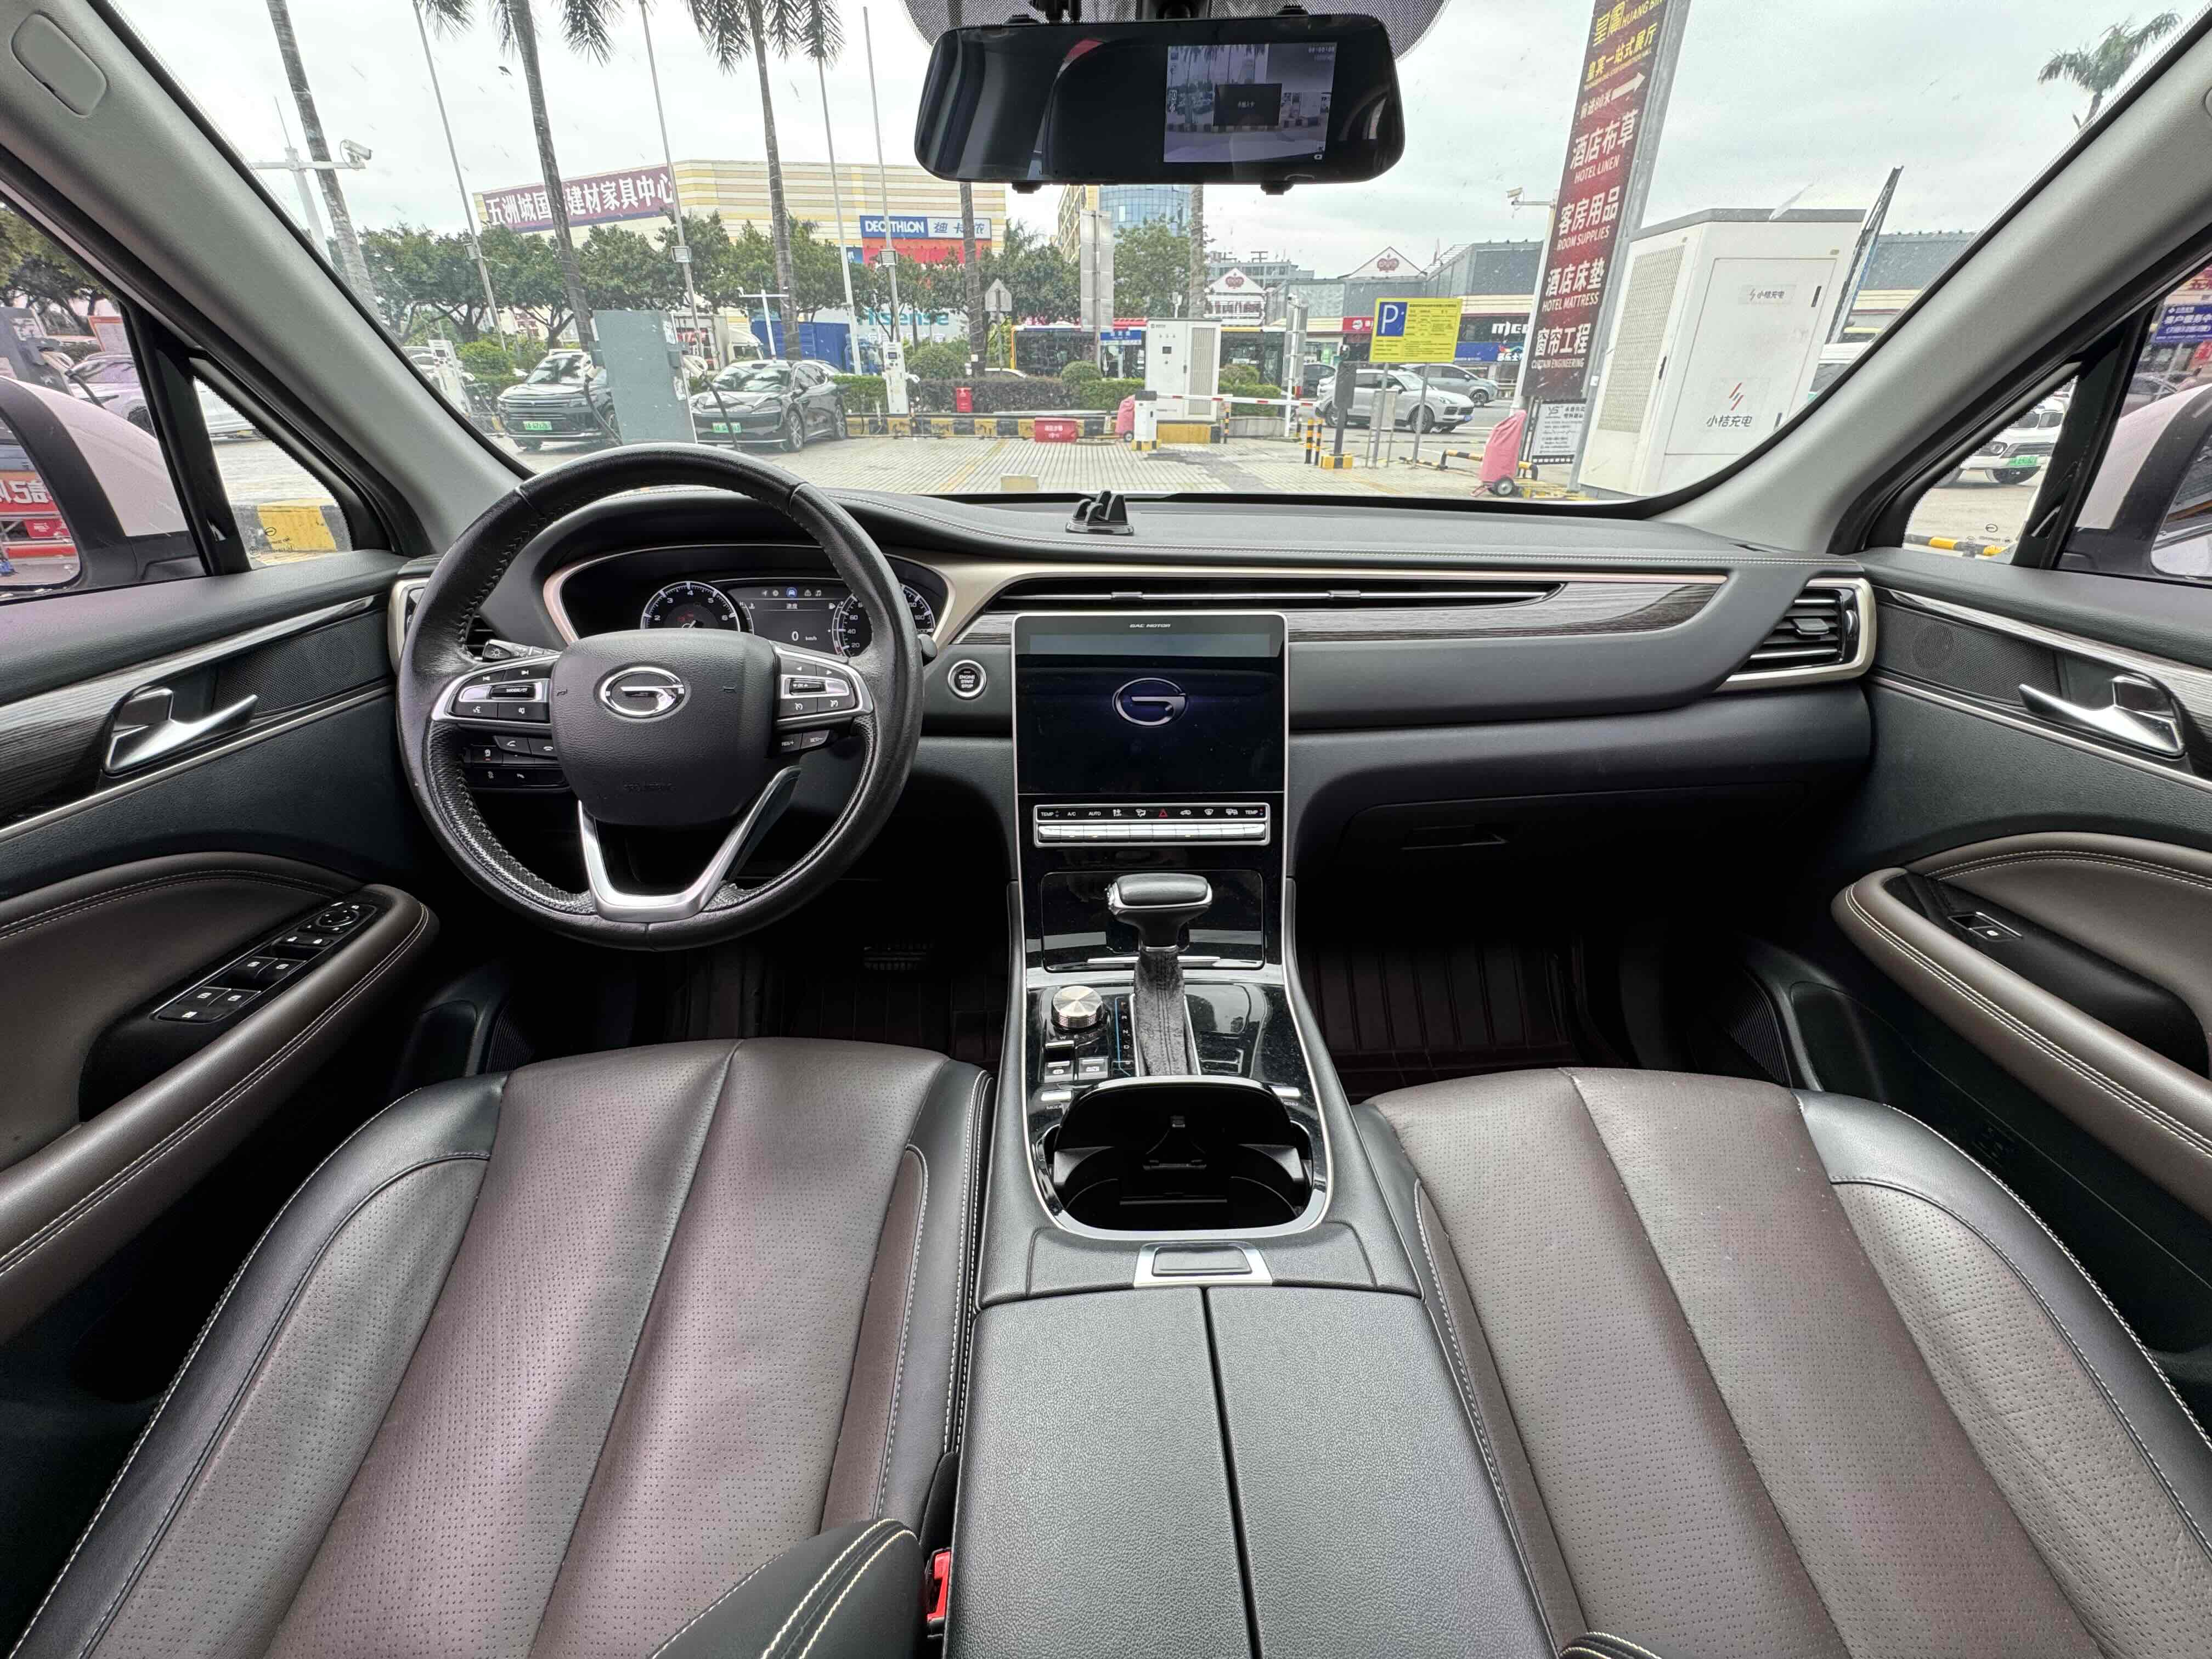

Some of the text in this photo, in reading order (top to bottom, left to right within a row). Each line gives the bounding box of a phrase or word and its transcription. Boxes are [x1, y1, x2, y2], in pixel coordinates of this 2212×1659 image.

[1570, 108, 1639, 170] 酒店布草
[1574, 154, 1620, 185] HOTEL LINEN
[486, 172, 675, 227] 五洲城国建材家具中心
[1558, 185, 1620, 236] 客房用品
[865, 219, 925, 233] DECTHLON
[1556, 225, 1611, 251] ROOM SUPPLIES
[1545, 256, 1605, 297] 酒店床垫
[1542, 291, 1600, 313] HOTEL MATTRESS
[1380, 304, 1399, 334] P
[1535, 323, 1591, 356] 窗帘工程
[1706, 415, 1753, 427] 小桔充电
[791, 630, 799, 641] 0
